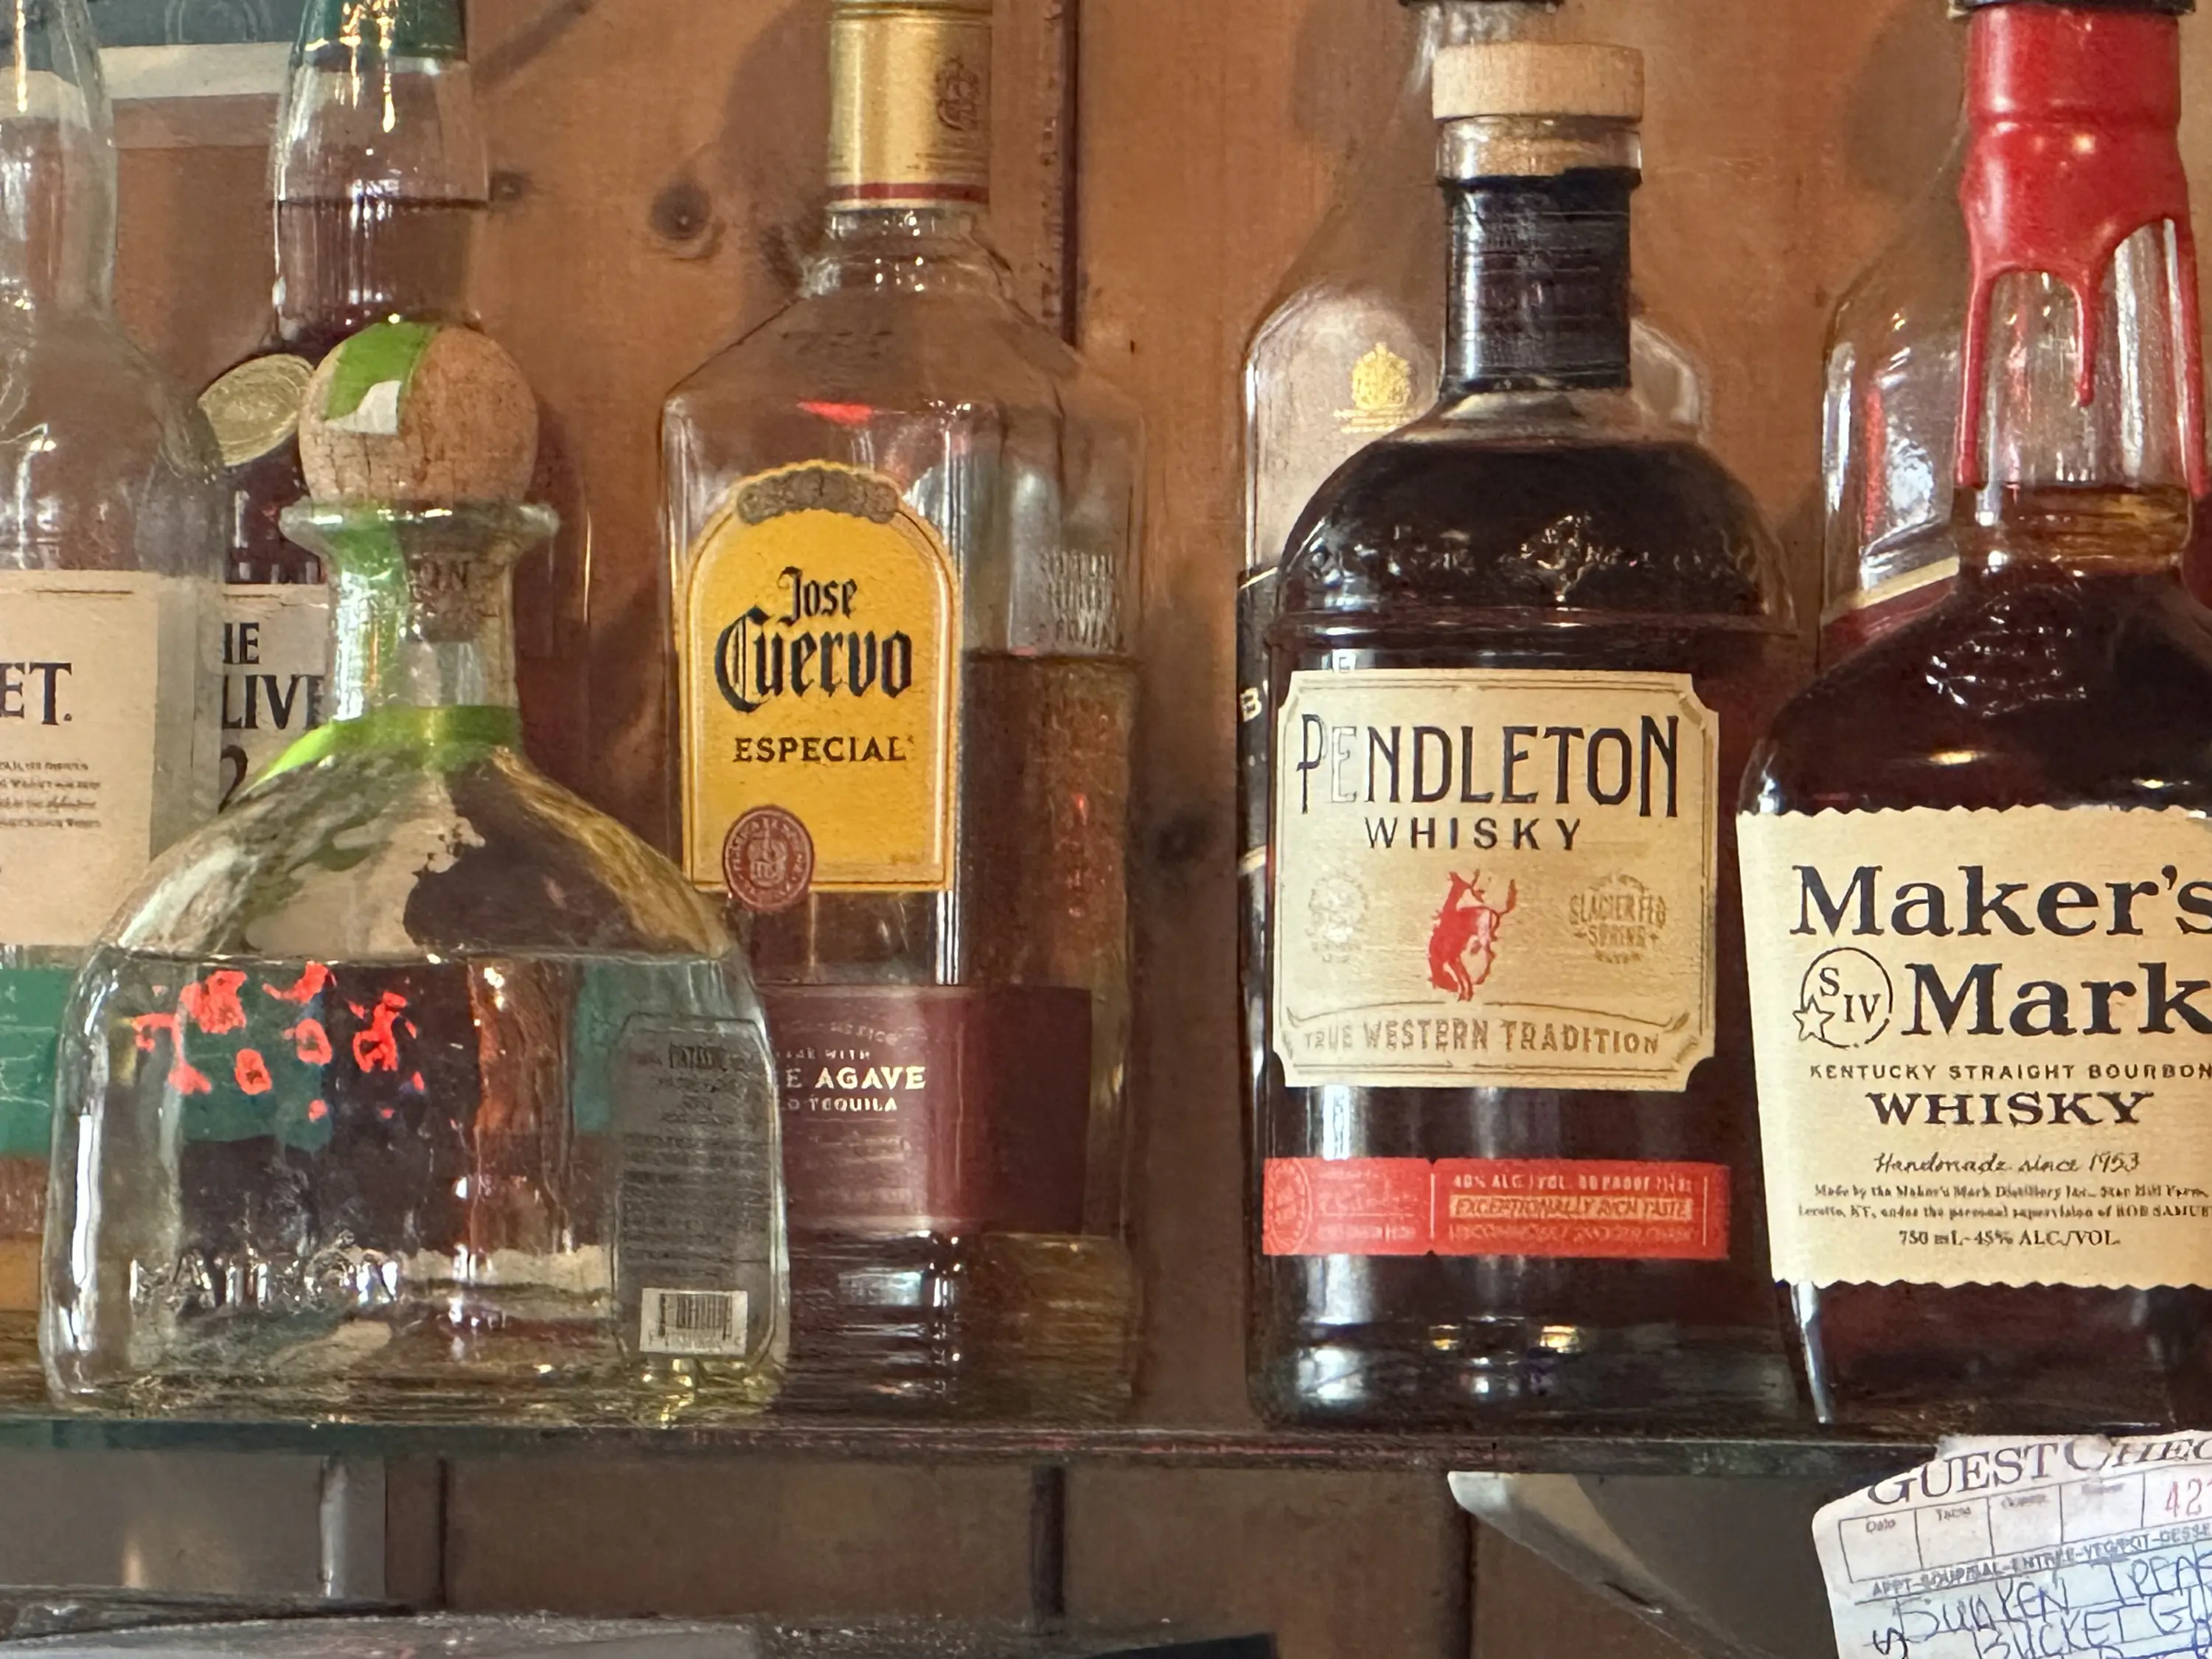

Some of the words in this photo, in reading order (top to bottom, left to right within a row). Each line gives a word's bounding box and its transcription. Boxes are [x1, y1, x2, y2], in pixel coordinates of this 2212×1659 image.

[777, 566, 858, 627] Jose
[714, 605, 913, 714] Cuervo
[733, 736, 907, 763] ESPECIAL
[1296, 713, 1679, 818] PENDLETON
[1364, 817, 1582, 850] WHISKY
[1790, 864, 2212, 938] Maker's
[1900, 961, 2212, 1036] Mark
[1363, 1018, 1489, 1053] WESTERN
[1499, 1020, 1660, 1056] TRADITION
[814, 1065, 926, 1090] AGAVE
[1809, 1064, 1937, 1081] KENTUCKY
[1949, 1063, 2076, 1080] STRAIGHT
[2088, 1063, 2212, 1080] BOURBON
[809, 1096, 898, 1112] TEQUILA
[1864, 1091, 2154, 1127] WHISKY
[1873, 1152, 2008, 1174] Handmade
[2017, 1154, 2080, 1173] since
[2089, 1151, 2140, 1174] 1953
[1953, 1186, 1991, 1198] Mark
[1868, 1441, 2059, 1506] GUEST
[2166, 1477, 2212, 1517] 42
